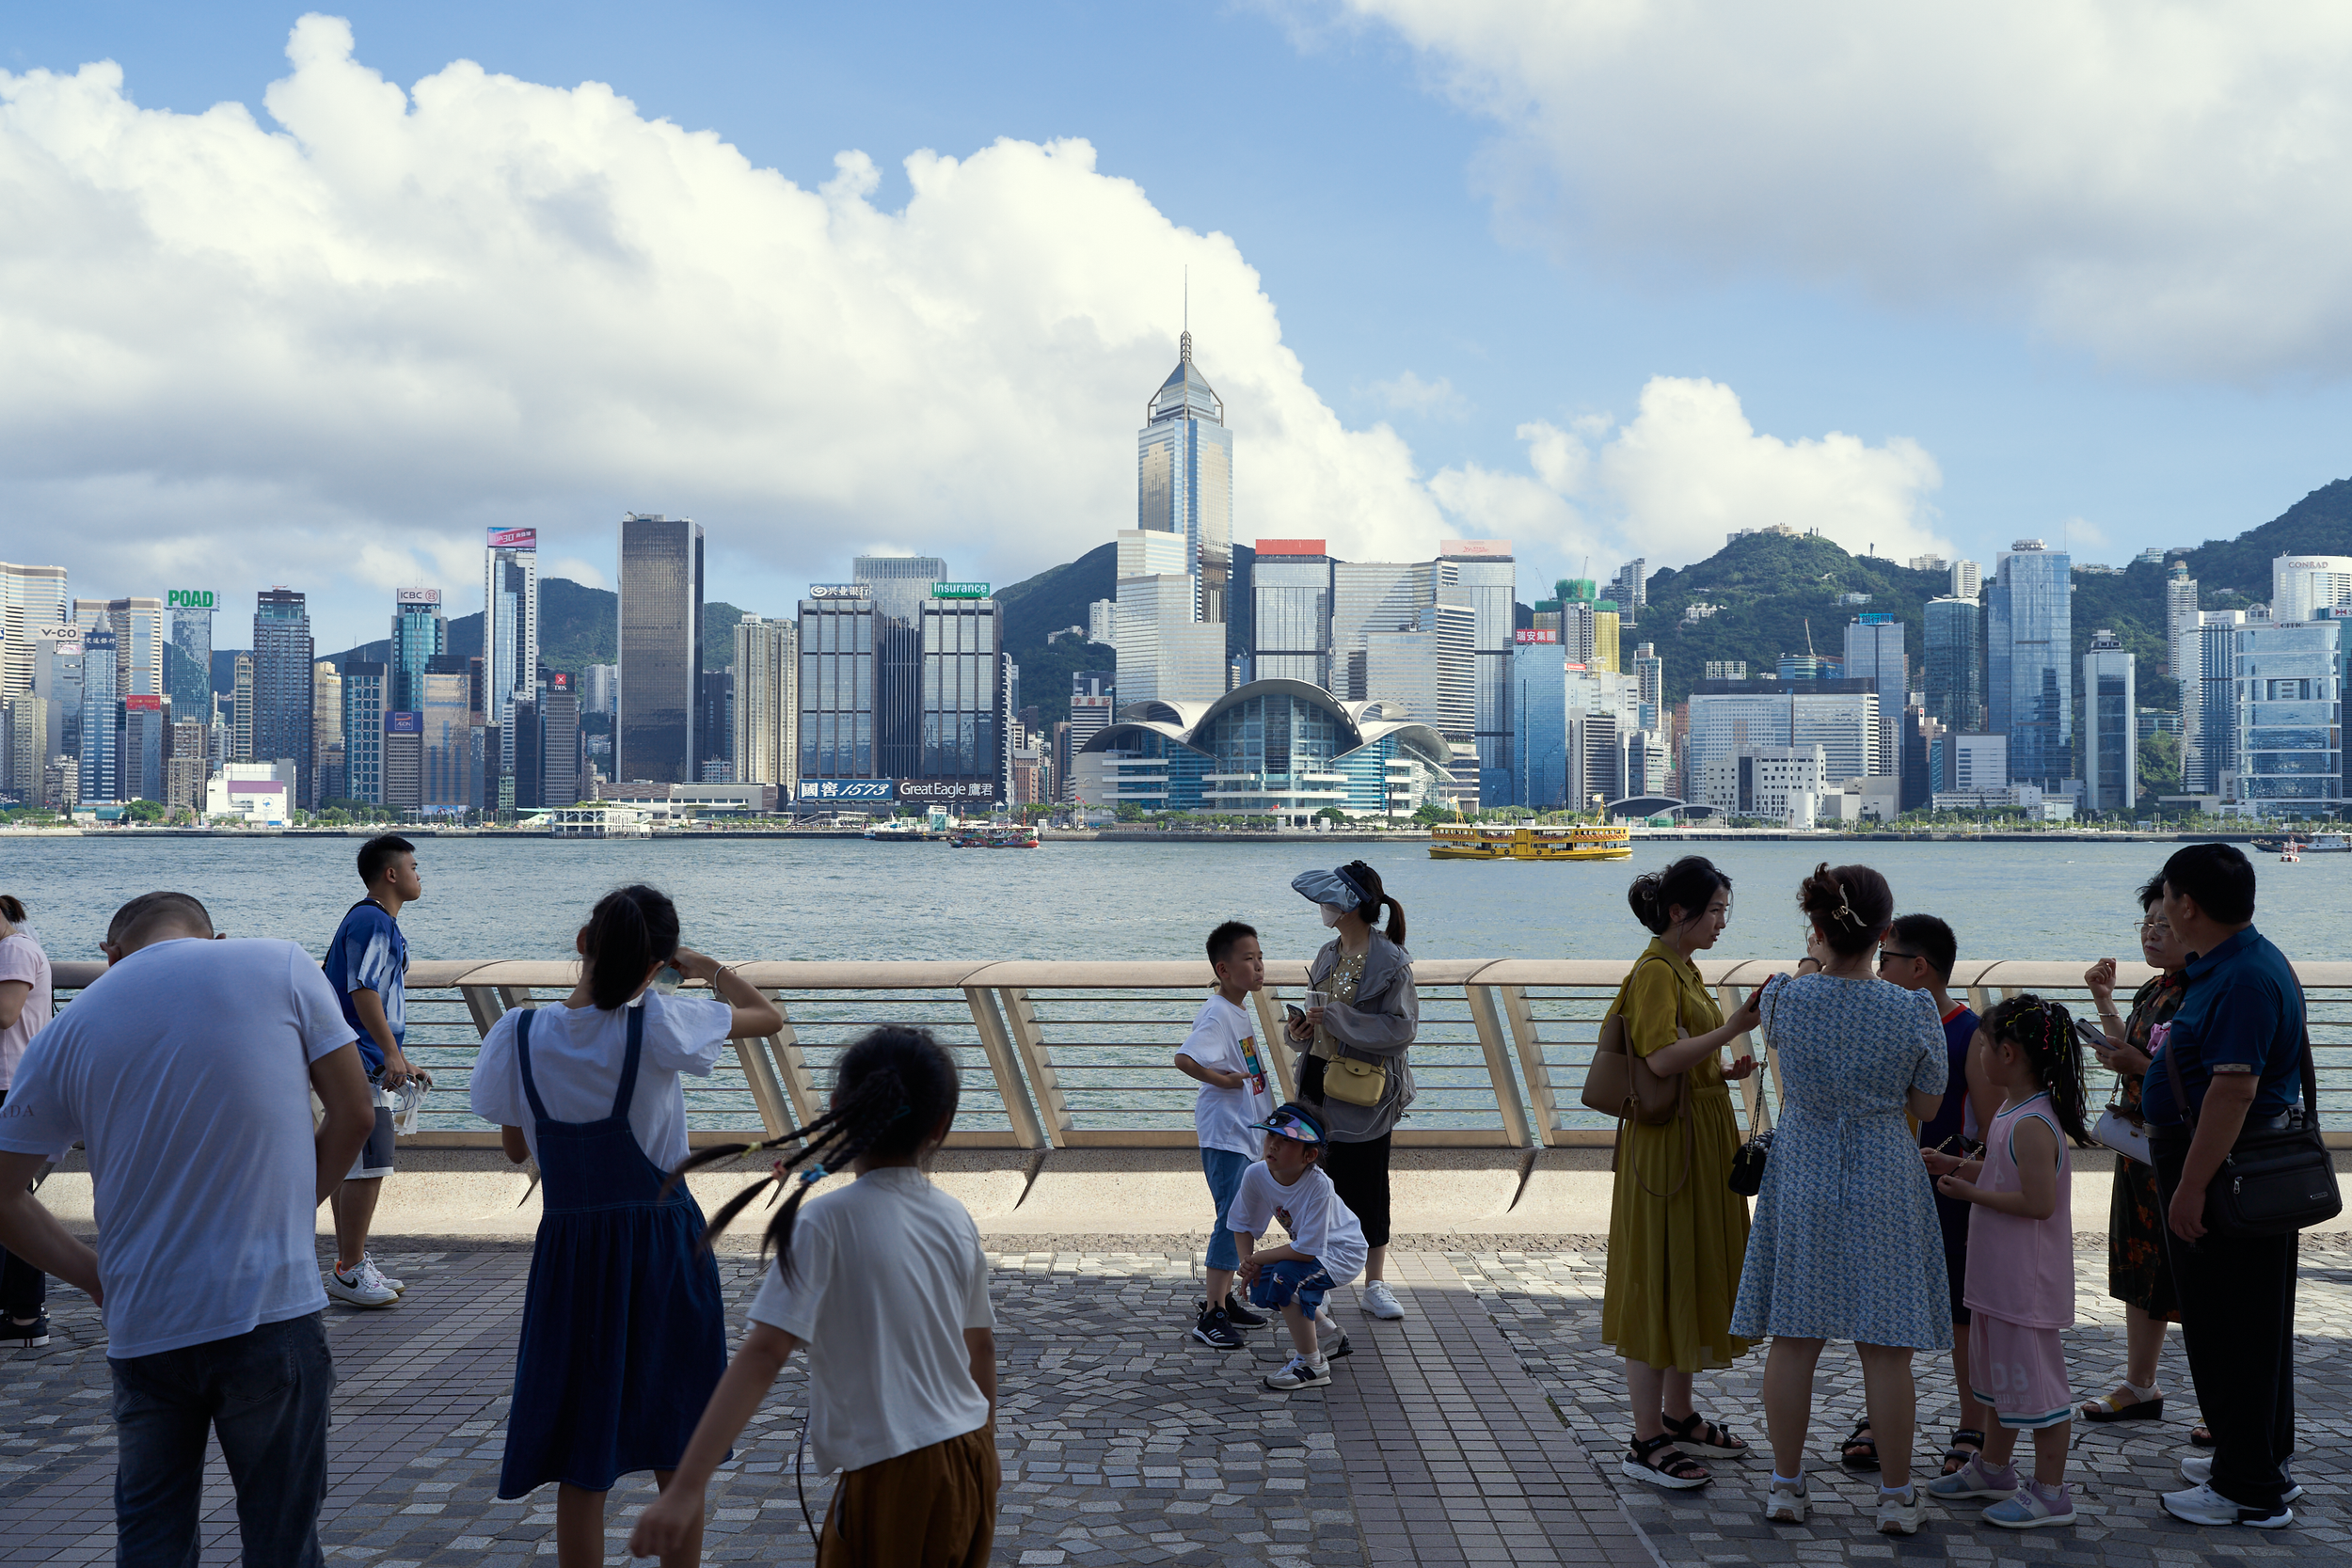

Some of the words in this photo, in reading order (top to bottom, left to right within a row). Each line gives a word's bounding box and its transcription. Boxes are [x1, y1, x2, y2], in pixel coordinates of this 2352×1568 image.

[2288, 561, 2328, 569] CONRAD
[828, 585, 868, 596] 兴业银行
[933, 582, 987, 594] Insurance
[168, 590, 214, 608] POAD
[400, 591, 422, 599] ICBC
[41, 628, 77, 638] V-CO
[1517, 631, 1556, 641] 瑞安集團
[1073, 697, 1111, 706] 李錦記
[900, 782, 934, 796] Great
[934, 782, 966, 799] Eagle
[968, 783, 994, 797] 鷹君
